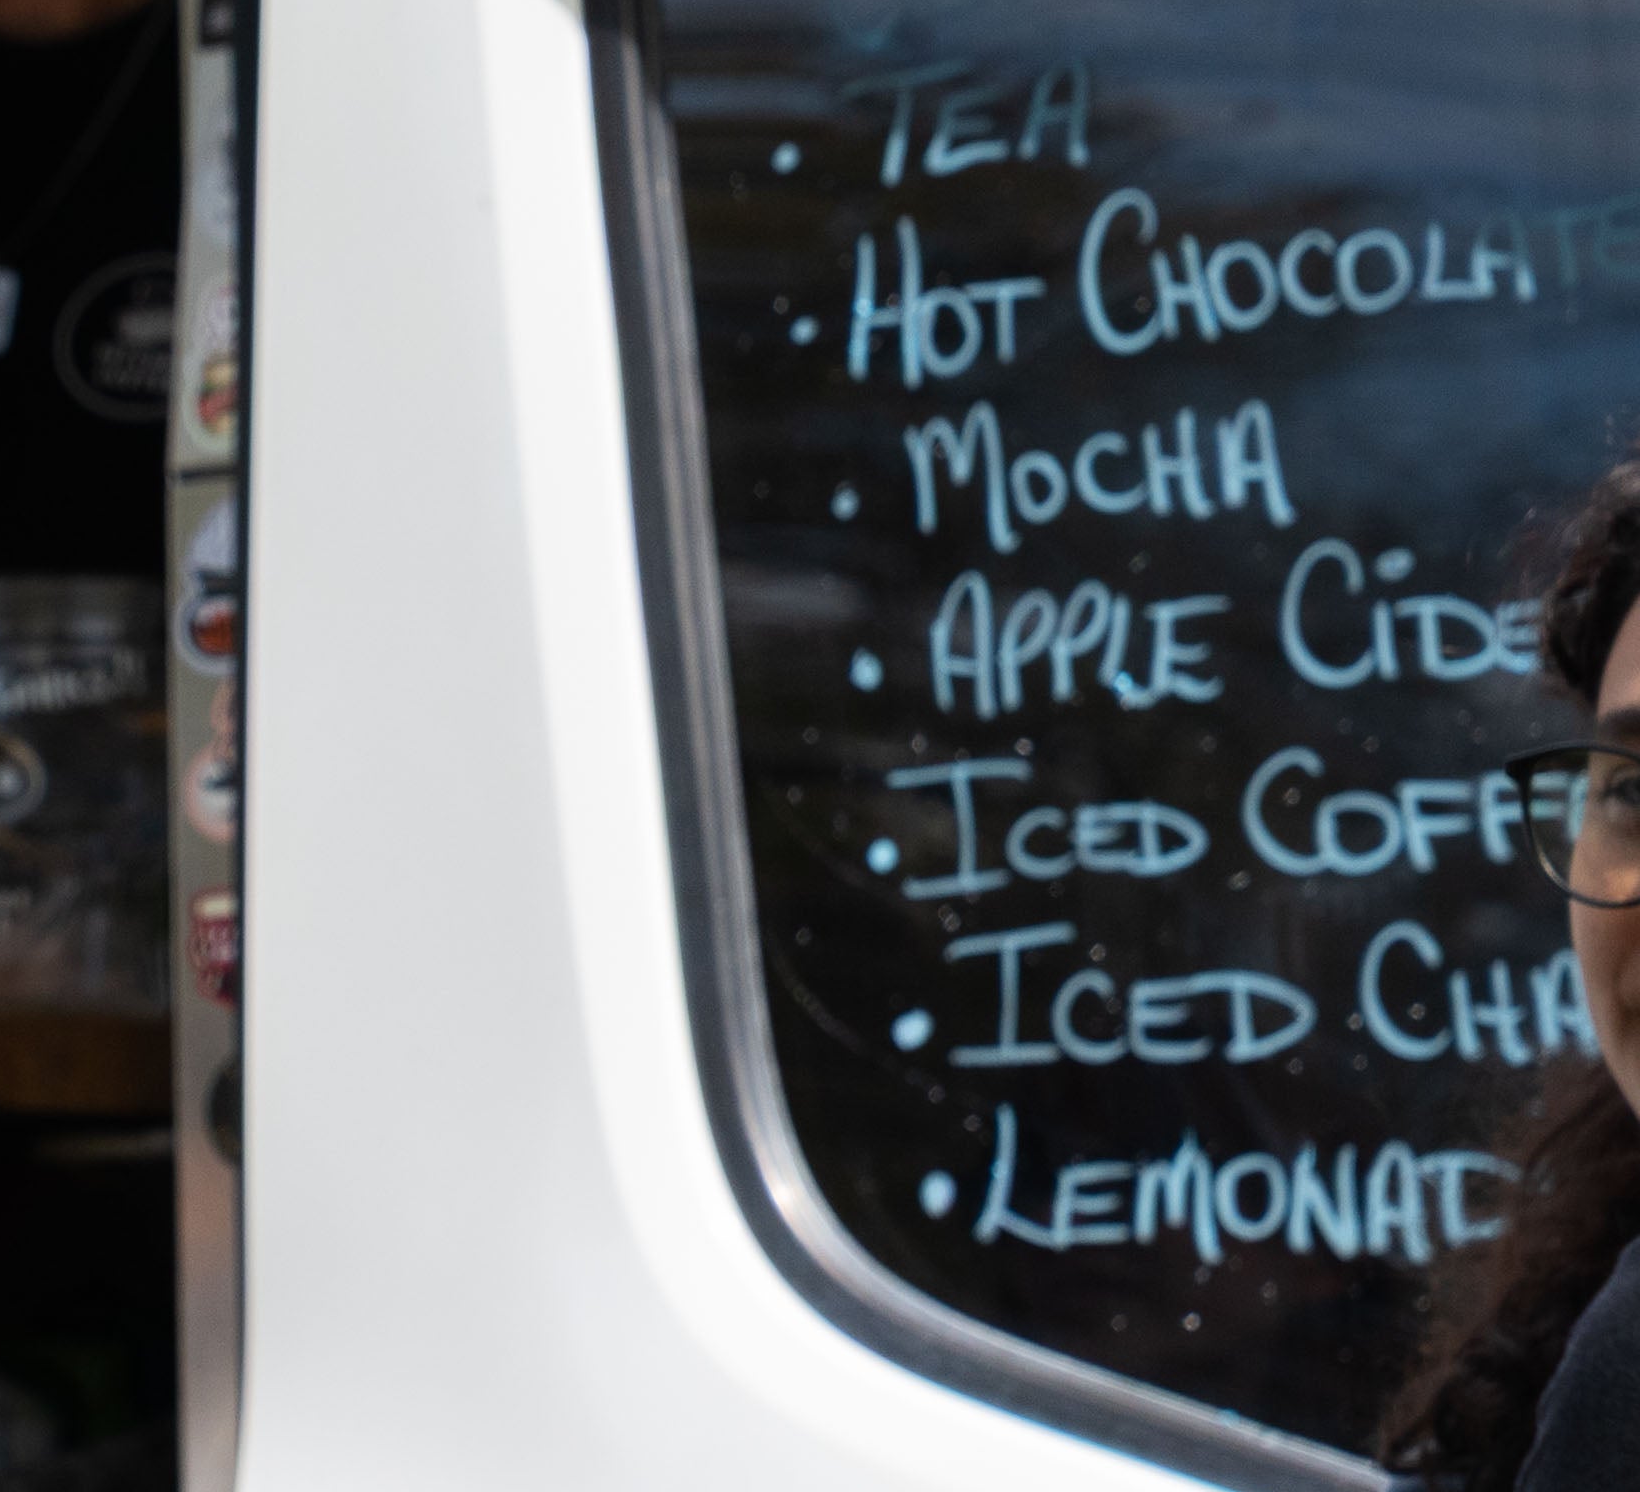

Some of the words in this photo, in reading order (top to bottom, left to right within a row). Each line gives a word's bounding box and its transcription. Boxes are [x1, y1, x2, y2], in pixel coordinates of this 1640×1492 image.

[842, 57, 1092, 188] TEA
[847, 214, 1047, 390] HOT
[904, 397, 1297, 554] MOCHA
[930, 569, 1232, 719] APPLE
[887, 756, 1209, 899] ICED
[1243, 747, 1590, 876] COFF
[945, 922, 1318, 1067] ICED
[1358, 919, 1603, 1068] CHA
[973, 1102, 1524, 1265] LEMONAD
